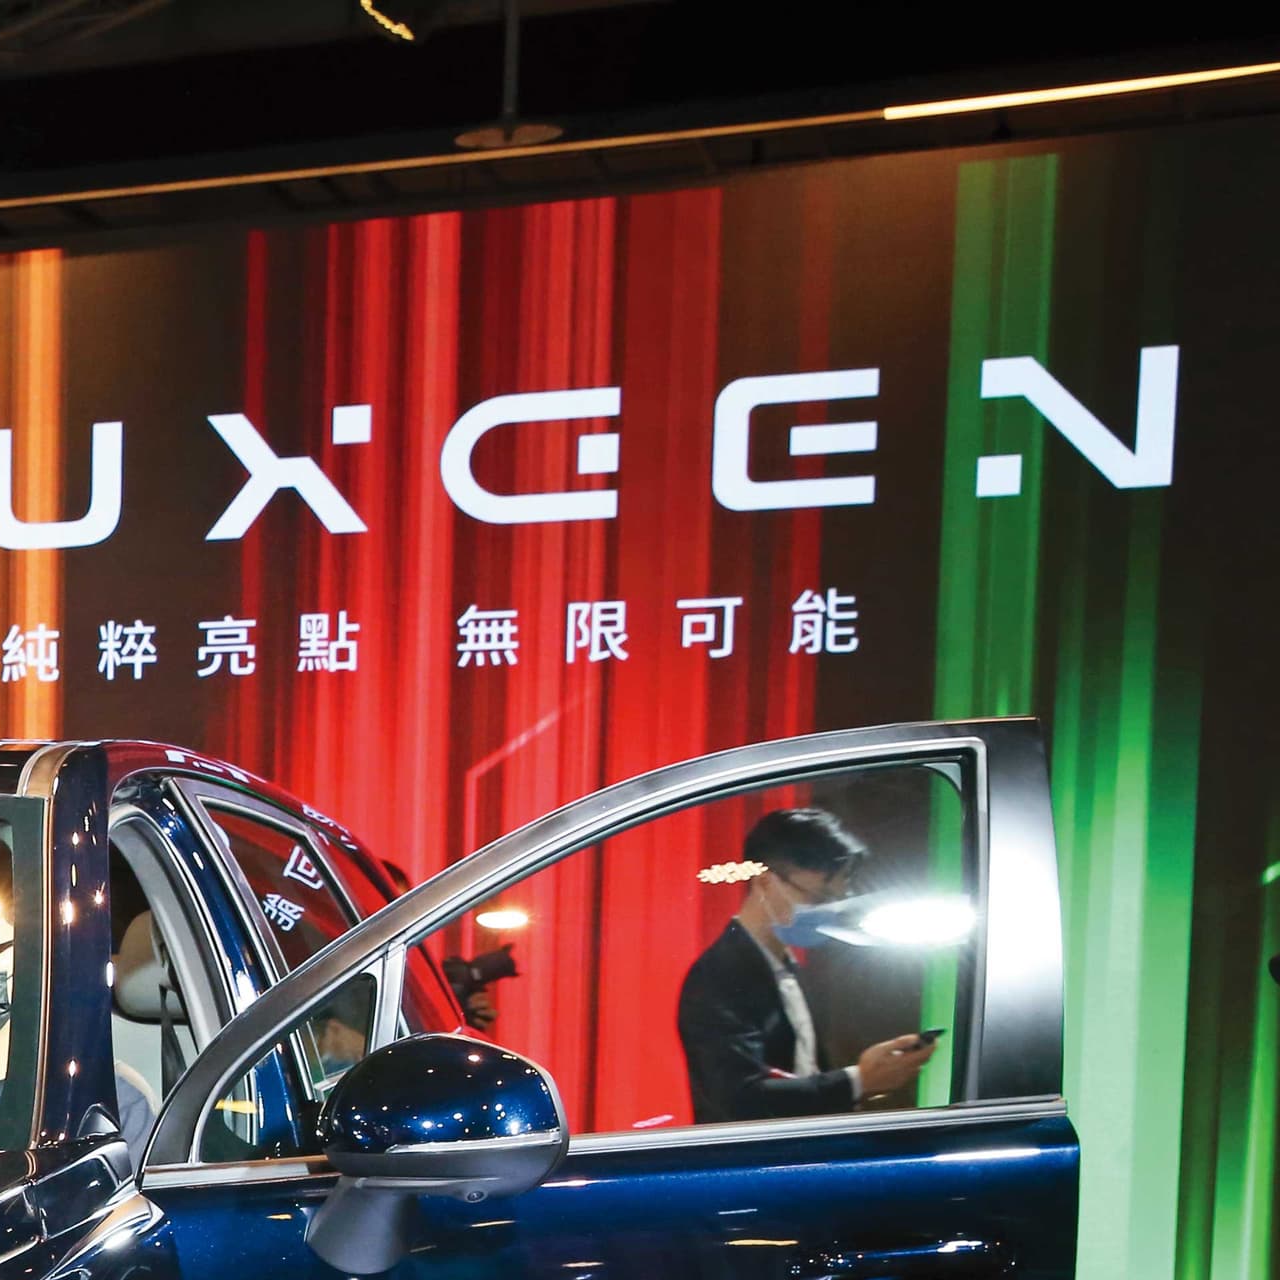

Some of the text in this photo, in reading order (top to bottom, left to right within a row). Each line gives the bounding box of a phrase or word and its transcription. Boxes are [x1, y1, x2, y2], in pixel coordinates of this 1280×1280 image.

[0, 586, 860, 684] 純粹亮點 無限可能
